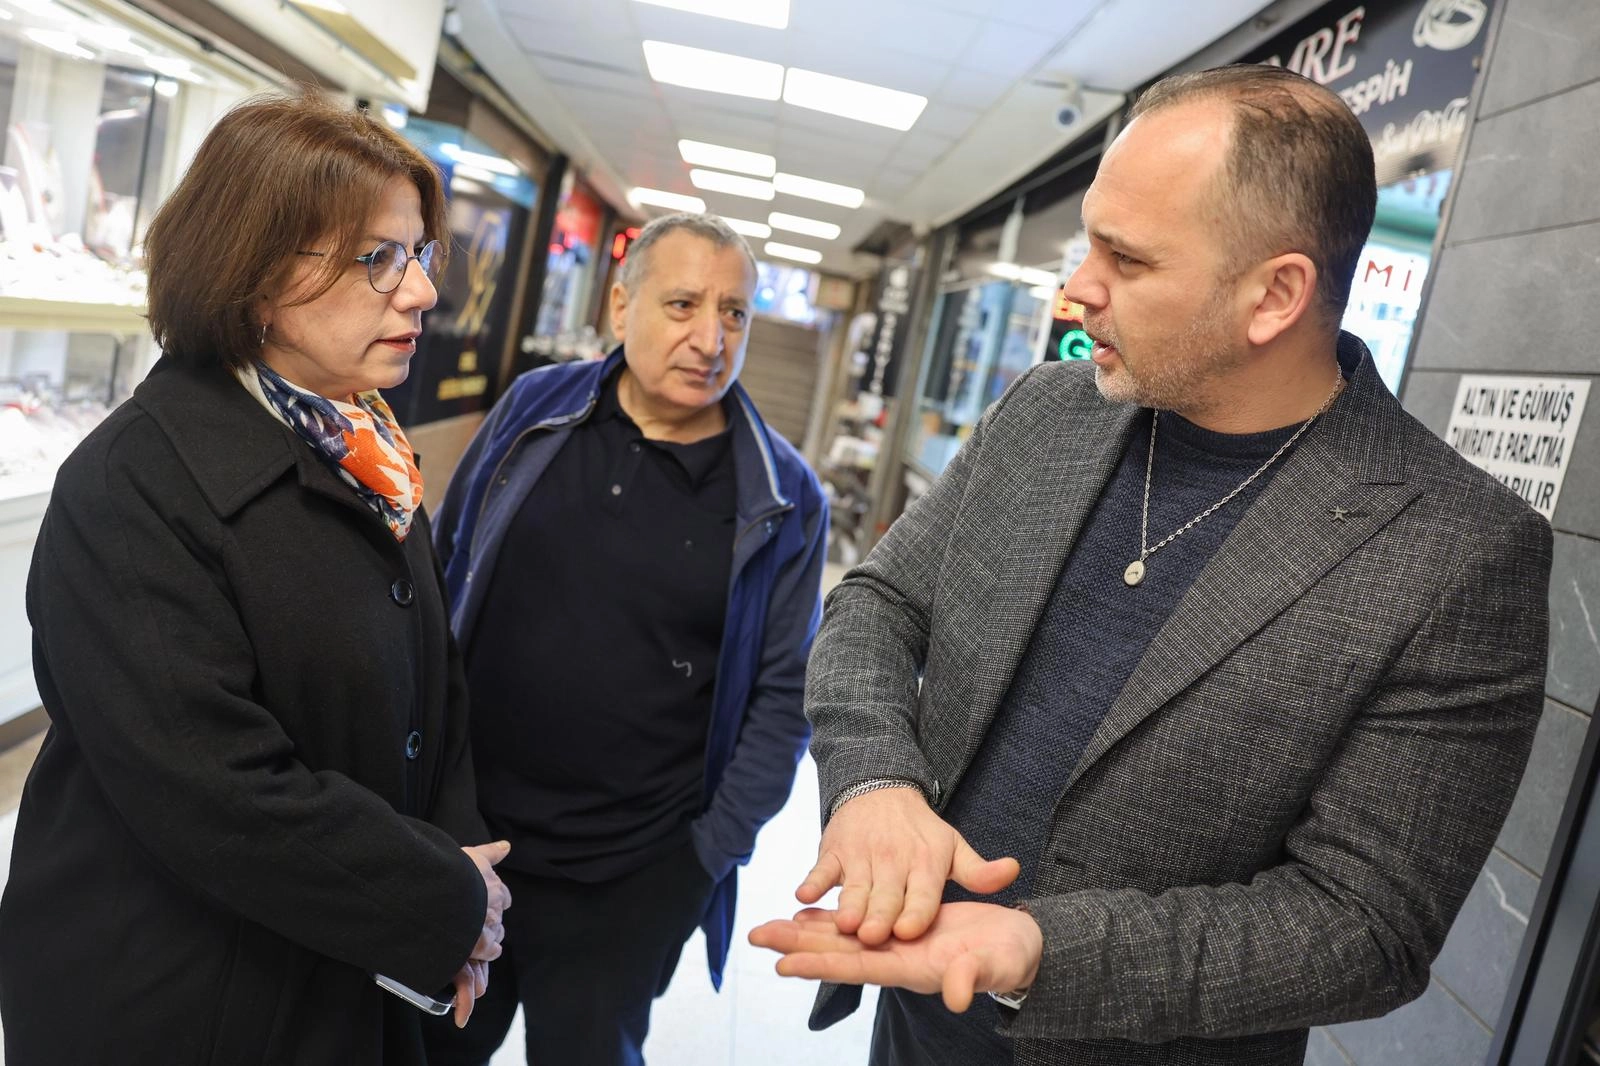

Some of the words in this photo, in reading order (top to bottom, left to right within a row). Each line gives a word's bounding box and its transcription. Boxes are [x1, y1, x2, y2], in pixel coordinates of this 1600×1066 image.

[1258, 6, 1366, 85] MRE
[1338, 58, 1414, 116] ESPİH
[1460, 386, 1500, 418] ALTIN
[1500, 387, 1519, 419] VE
[1519, 383, 1575, 432] GÜMÜŞ
[1503, 432, 1566, 469] PARLATMA
[1493, 472, 1556, 510] PILIR
